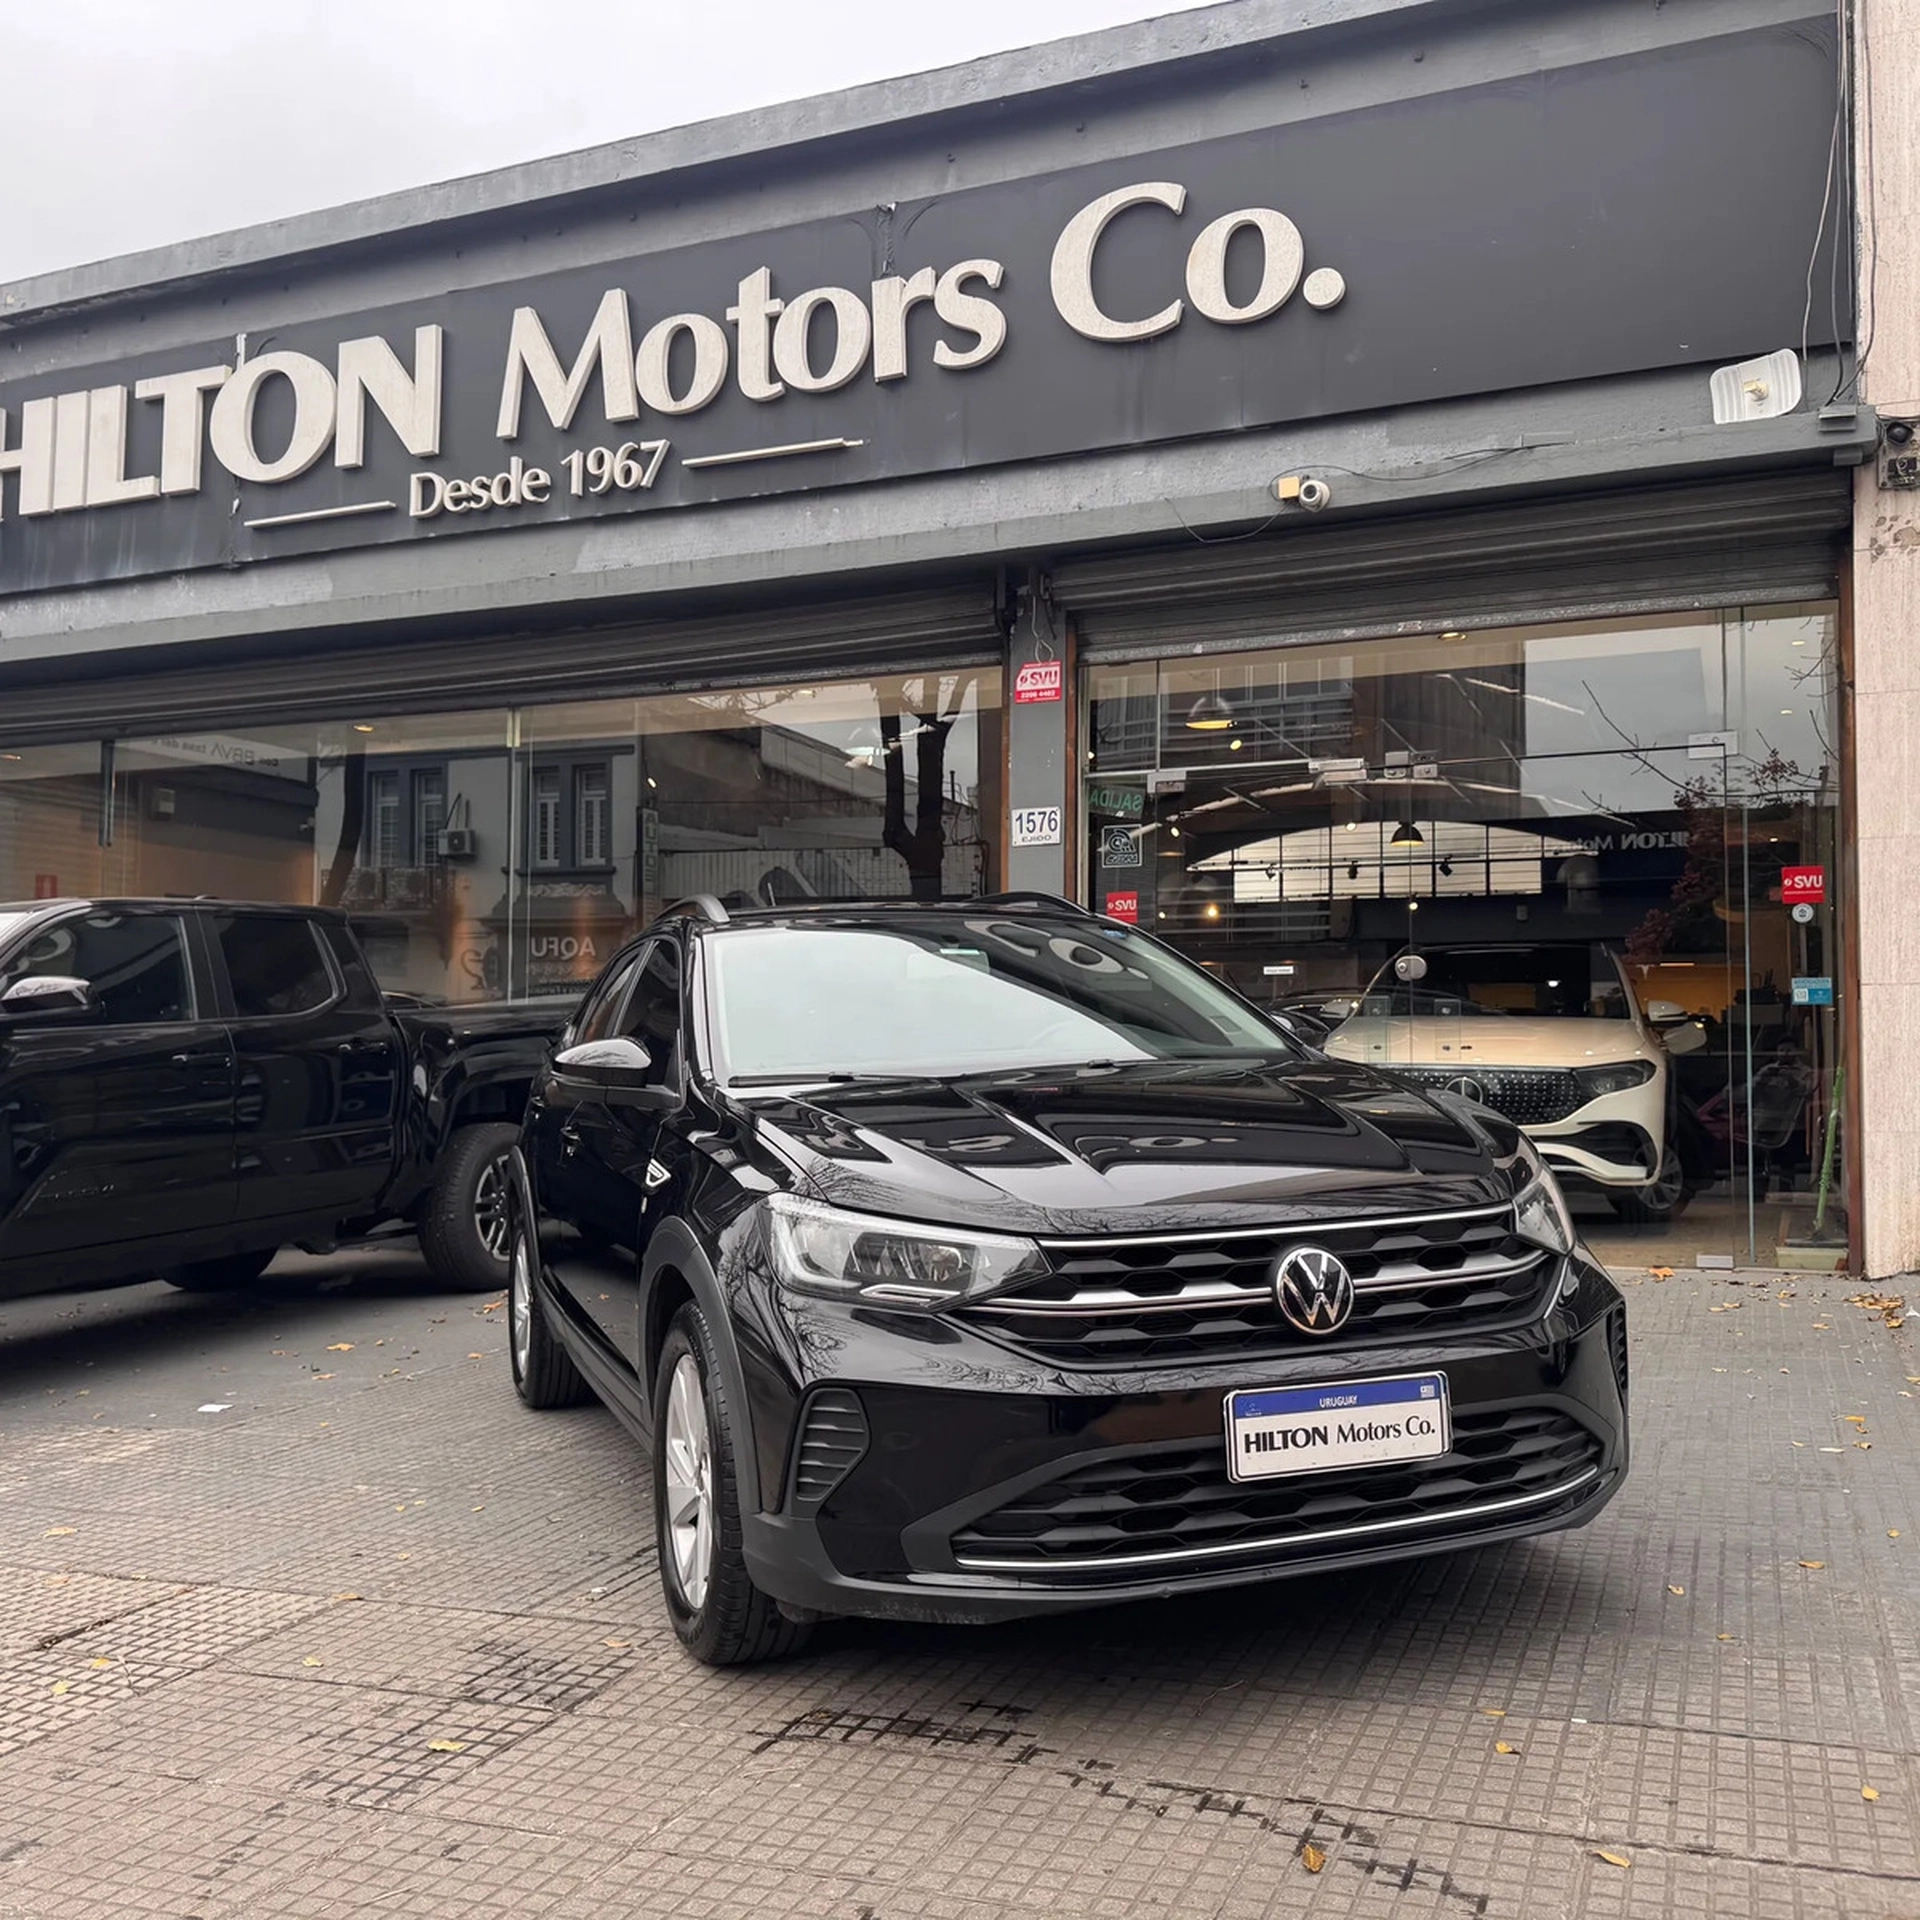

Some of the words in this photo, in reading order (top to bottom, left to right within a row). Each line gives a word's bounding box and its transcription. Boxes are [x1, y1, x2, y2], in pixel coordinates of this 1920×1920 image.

[0, 324, 442, 522] HILTON
[496, 259, 1006, 440] Motors
[1050, 181, 1346, 343] Co.
[409, 456, 551, 519] Desde
[560, 438, 671, 497] 1967
[1030, 670, 1058, 686] SVU
[1015, 810, 1059, 834] 1576
[1793, 874, 1823, 889] SVU
[1114, 899, 1137, 911] SVU
[1318, 1394, 1359, 1409] URUGUAY
[1244, 1425, 1329, 1454] HILTON
[1336, 1421, 1402, 1444] Motors
[1405, 1415, 1436, 1437] Co.
